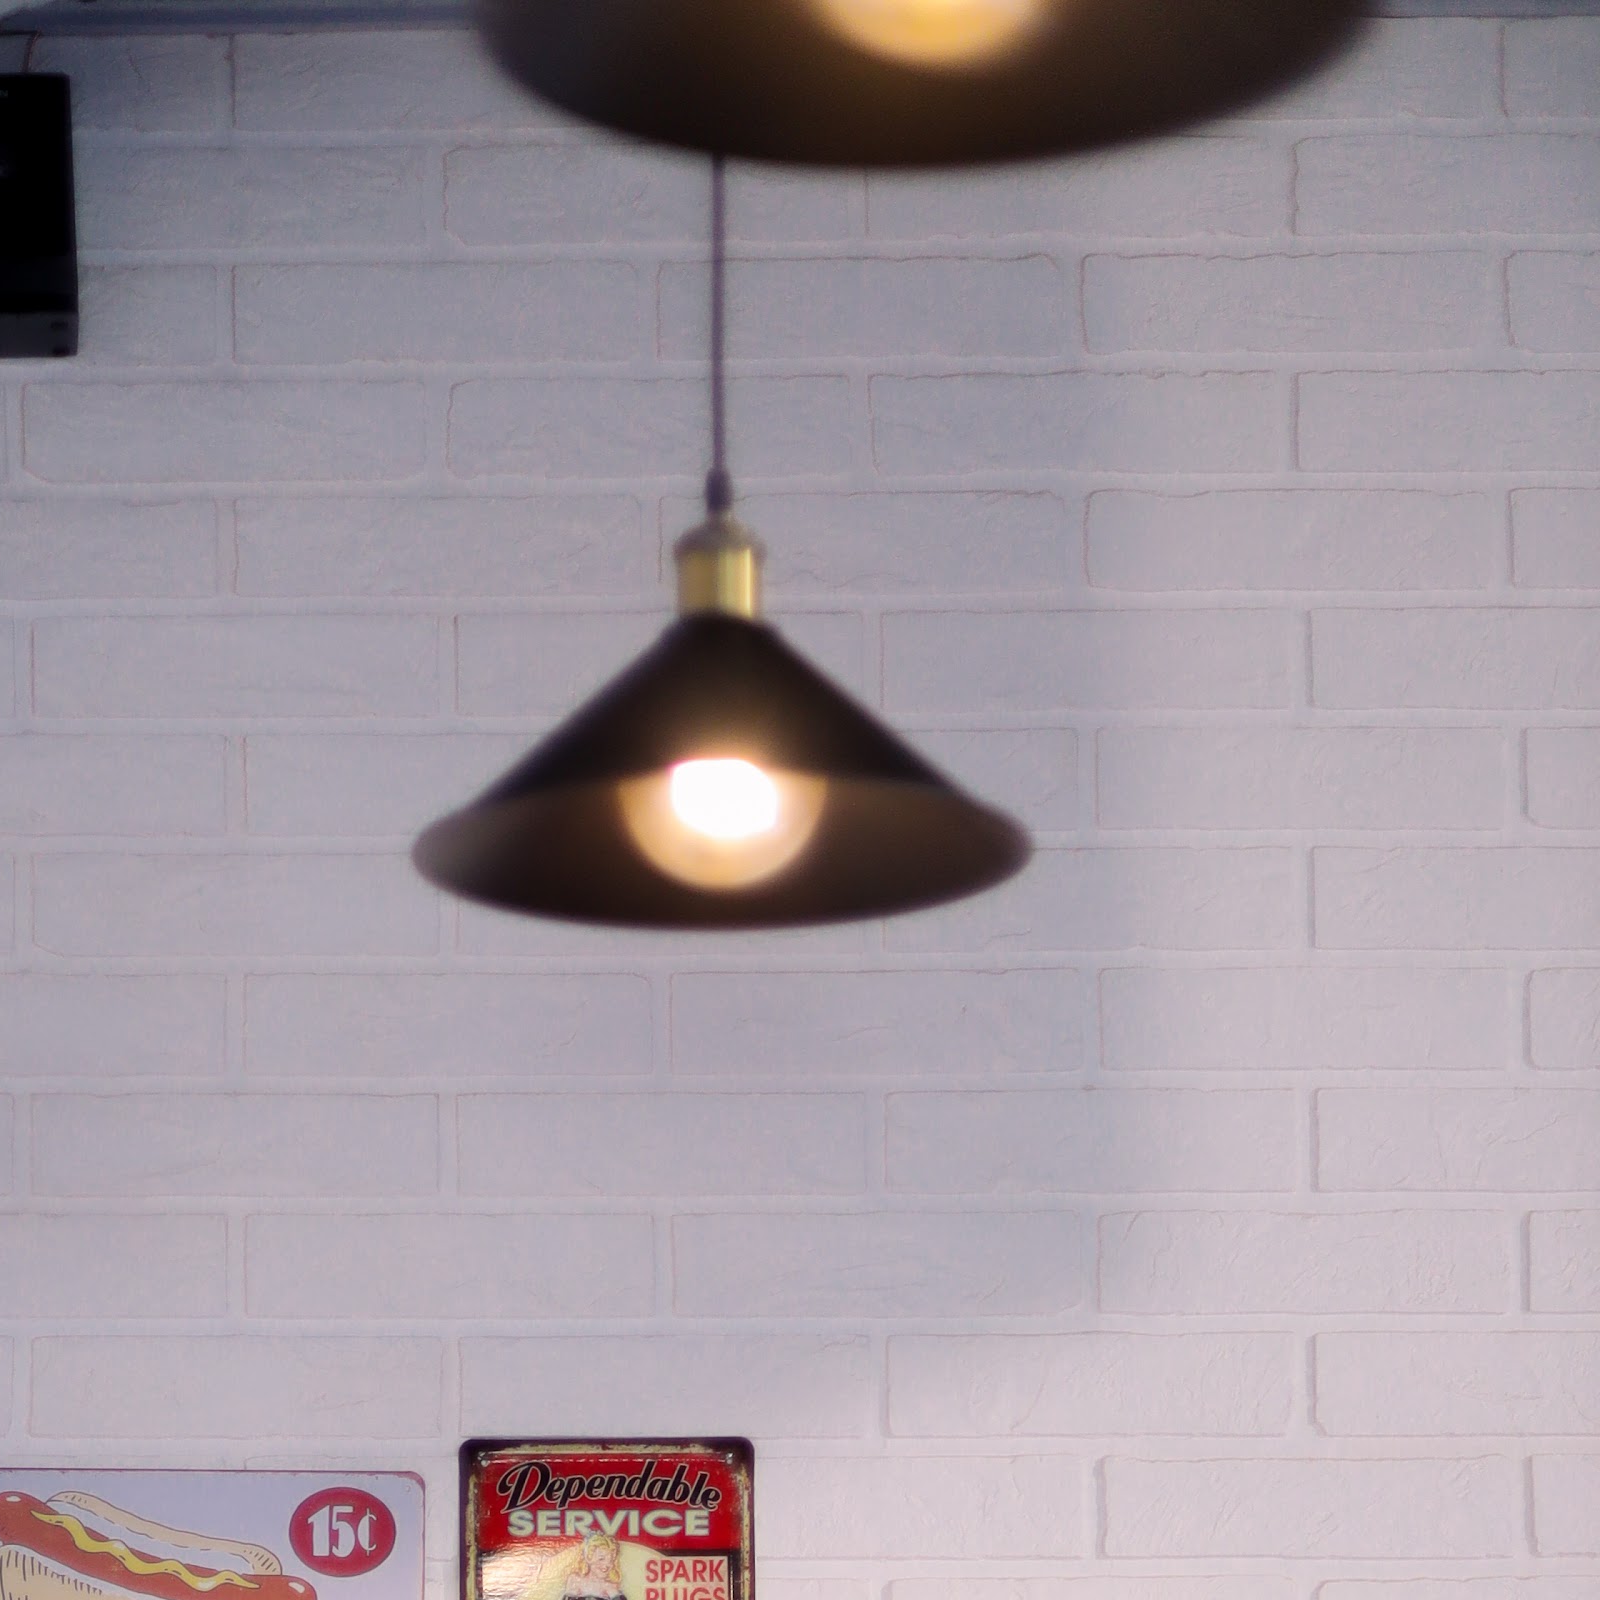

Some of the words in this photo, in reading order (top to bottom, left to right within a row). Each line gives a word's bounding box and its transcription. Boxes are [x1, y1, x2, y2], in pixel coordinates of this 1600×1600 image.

[497, 1461, 722, 1514] Dependable
[507, 1509, 710, 1537] SERVICE
[645, 1559, 725, 1583] SPARK
